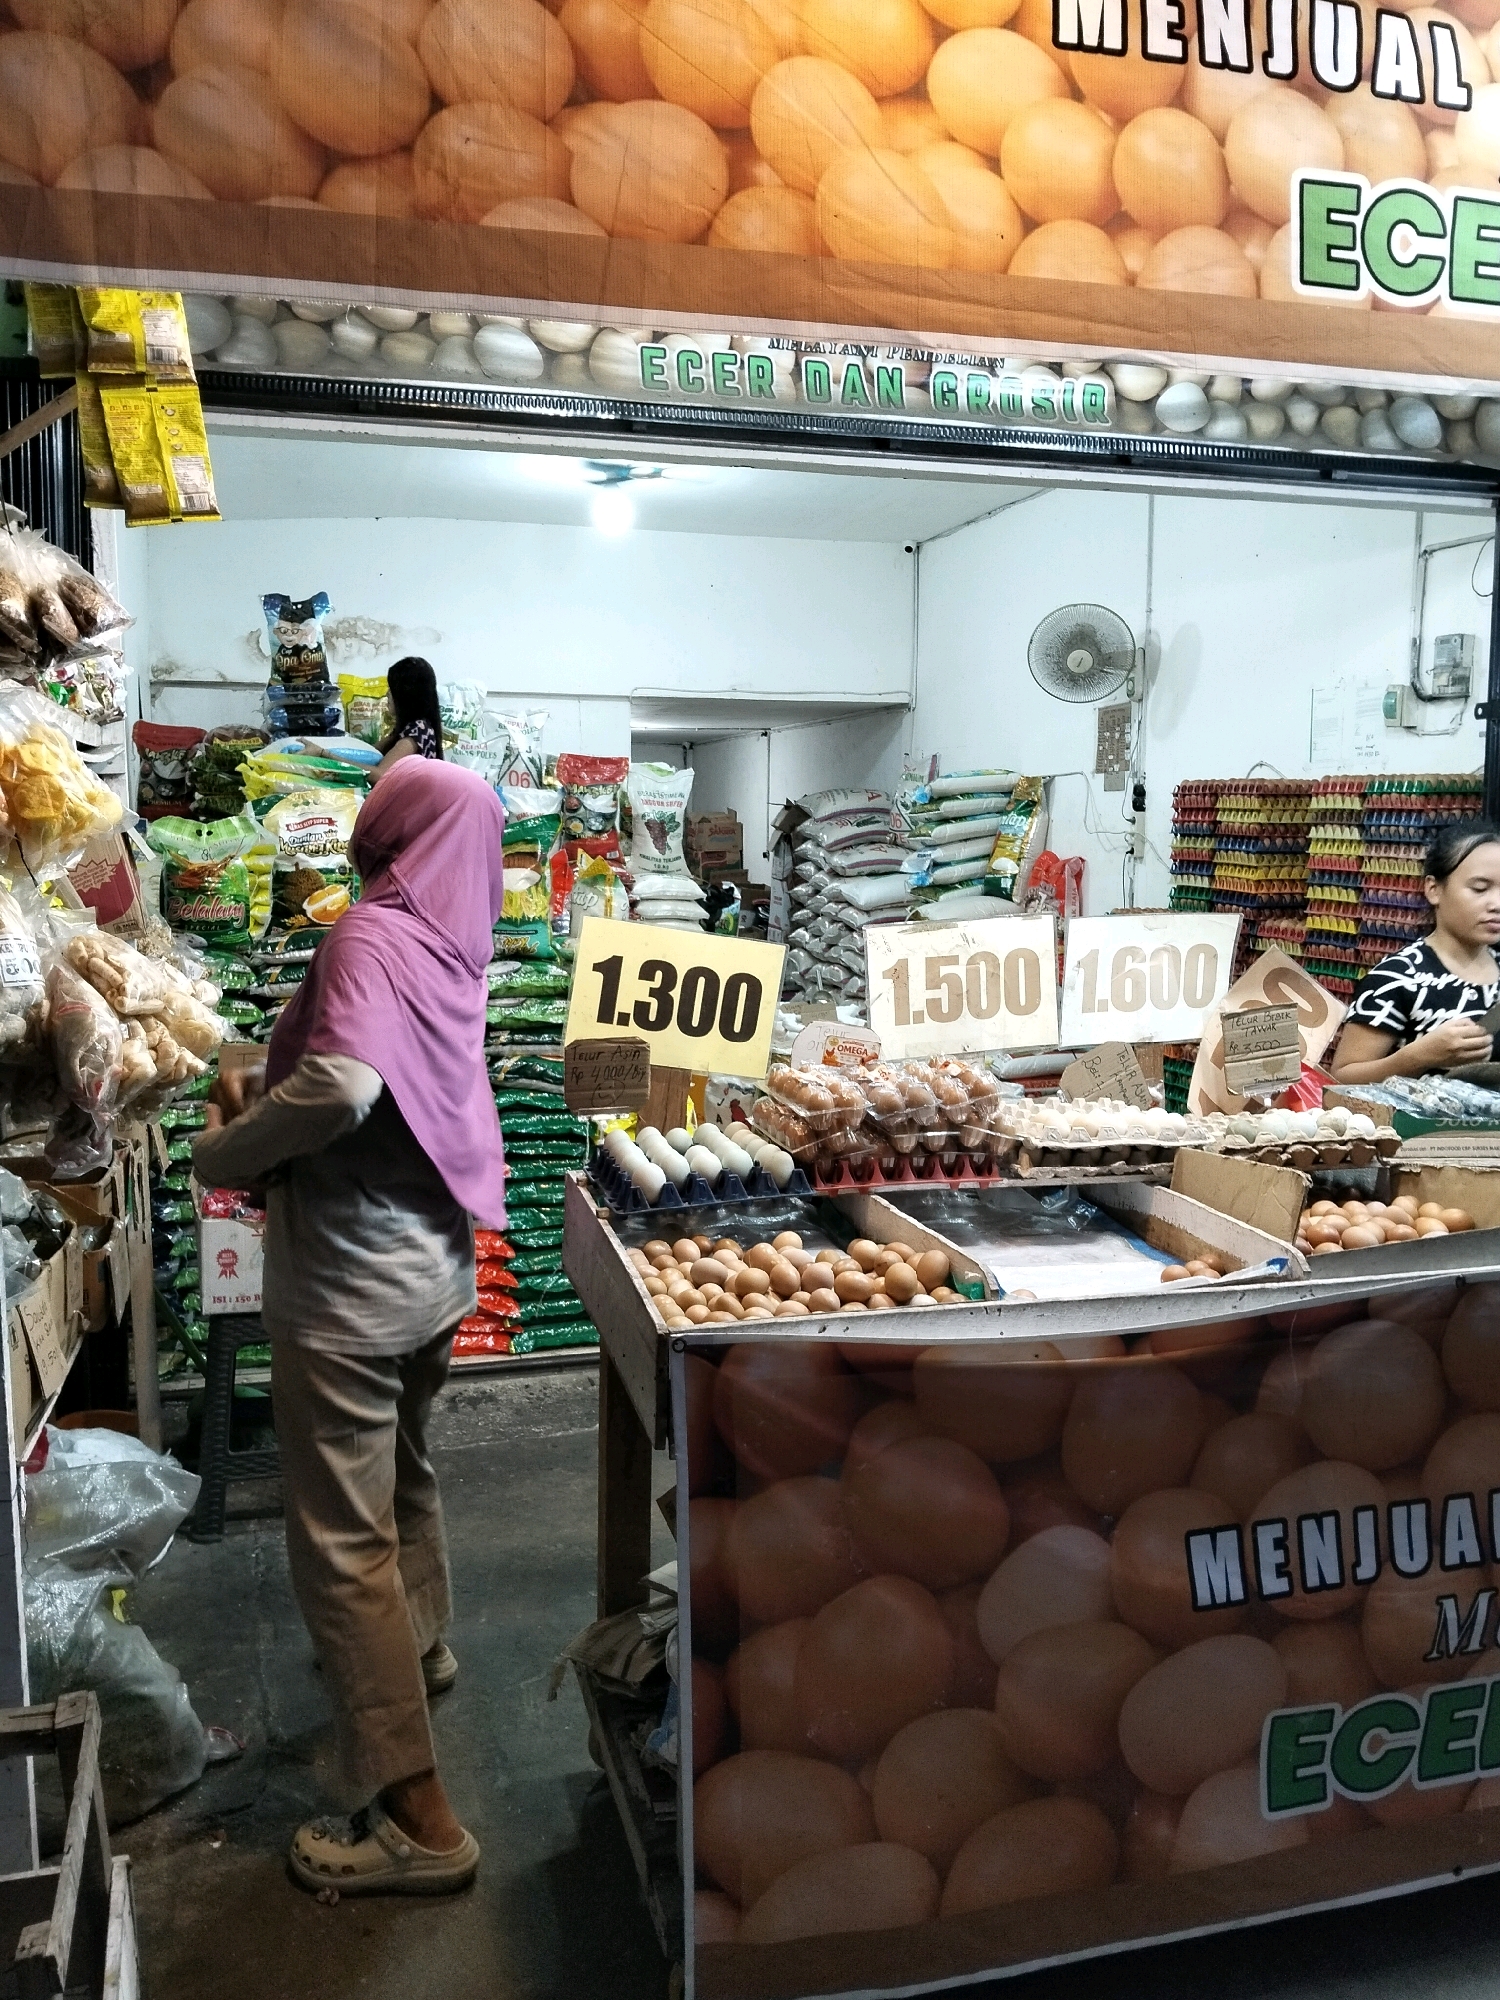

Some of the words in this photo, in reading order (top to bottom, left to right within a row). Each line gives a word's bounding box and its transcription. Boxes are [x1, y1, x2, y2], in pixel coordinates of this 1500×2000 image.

[1050, 0, 1473, 111] MENJUAL
[639, 345, 777, 399] ECER
[804, 359, 905, 409] DAN
[932, 370, 1110, 424] GROSIR
[509, 769, 531, 788] 06
[890, 812, 903, 829] 06
[167, 895, 245, 928] Belalang
[592, 954, 763, 1043] 1.300
[882, 947, 1041, 1027] 1.500
[1078, 943, 1219, 1014] 1.600
[611, 1045, 641, 1062] Asin
[837, 1044, 868, 1056] OMEGA
[1241, 1023, 1278, 1037] TAWAR
[1185, 1488, 1500, 1612] MENJUA
